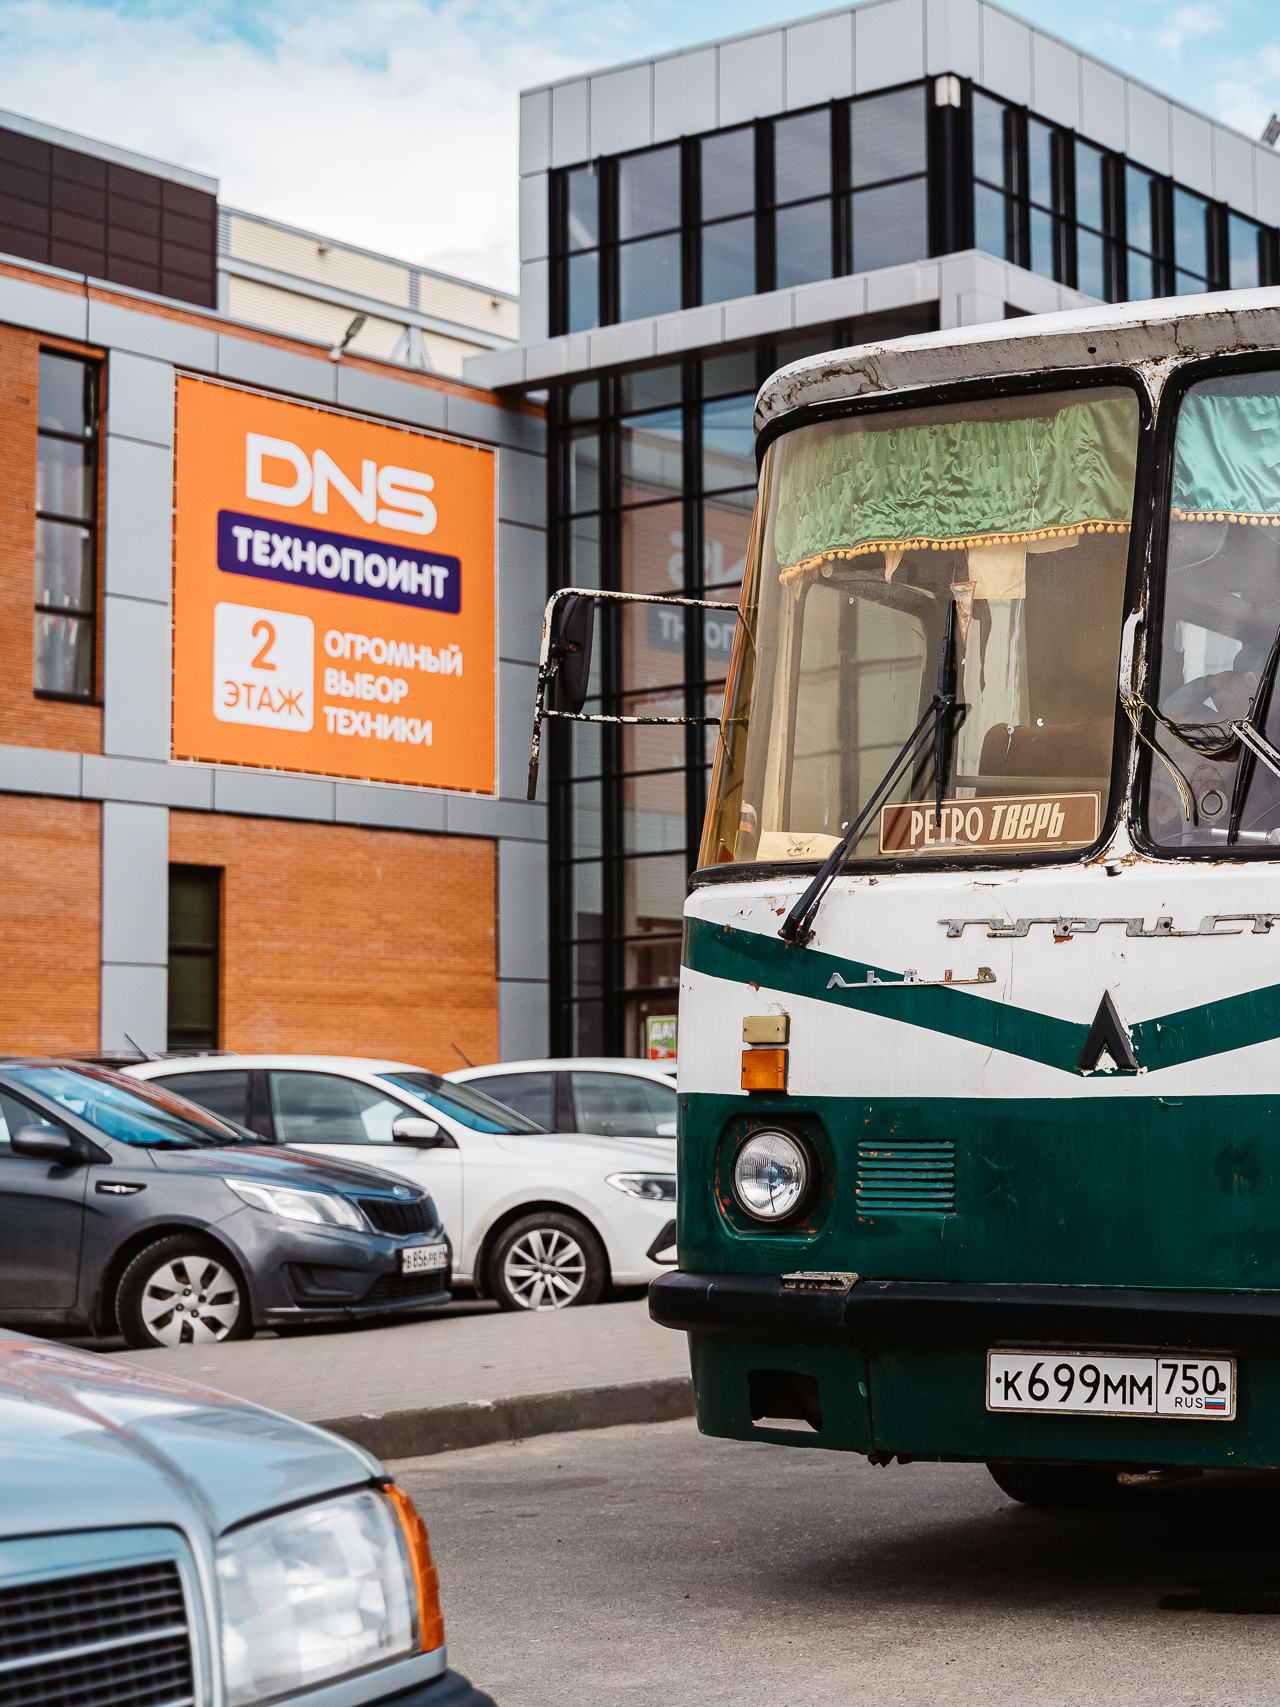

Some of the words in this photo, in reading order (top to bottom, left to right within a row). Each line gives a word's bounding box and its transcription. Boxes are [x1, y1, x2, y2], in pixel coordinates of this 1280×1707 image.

[246, 432, 438, 535] DNS
[232, 525, 449, 599] ТЕХНОПОИНТ
[251, 619, 277, 671] 2
[323, 629, 463, 676] ОГРОМНЫЙ
[223, 681, 305, 717] ЭТАЖ
[324, 668, 408, 704] ВЫБОР
[323, 706, 433, 746] ТЕХНИКИ
[910, 806, 984, 845] РЕТРО
[1004, 1362, 1153, 1405] К699ММ
[1161, 1363, 1220, 1395] 750
[1175, 1397, 1203, 1408] RUS
